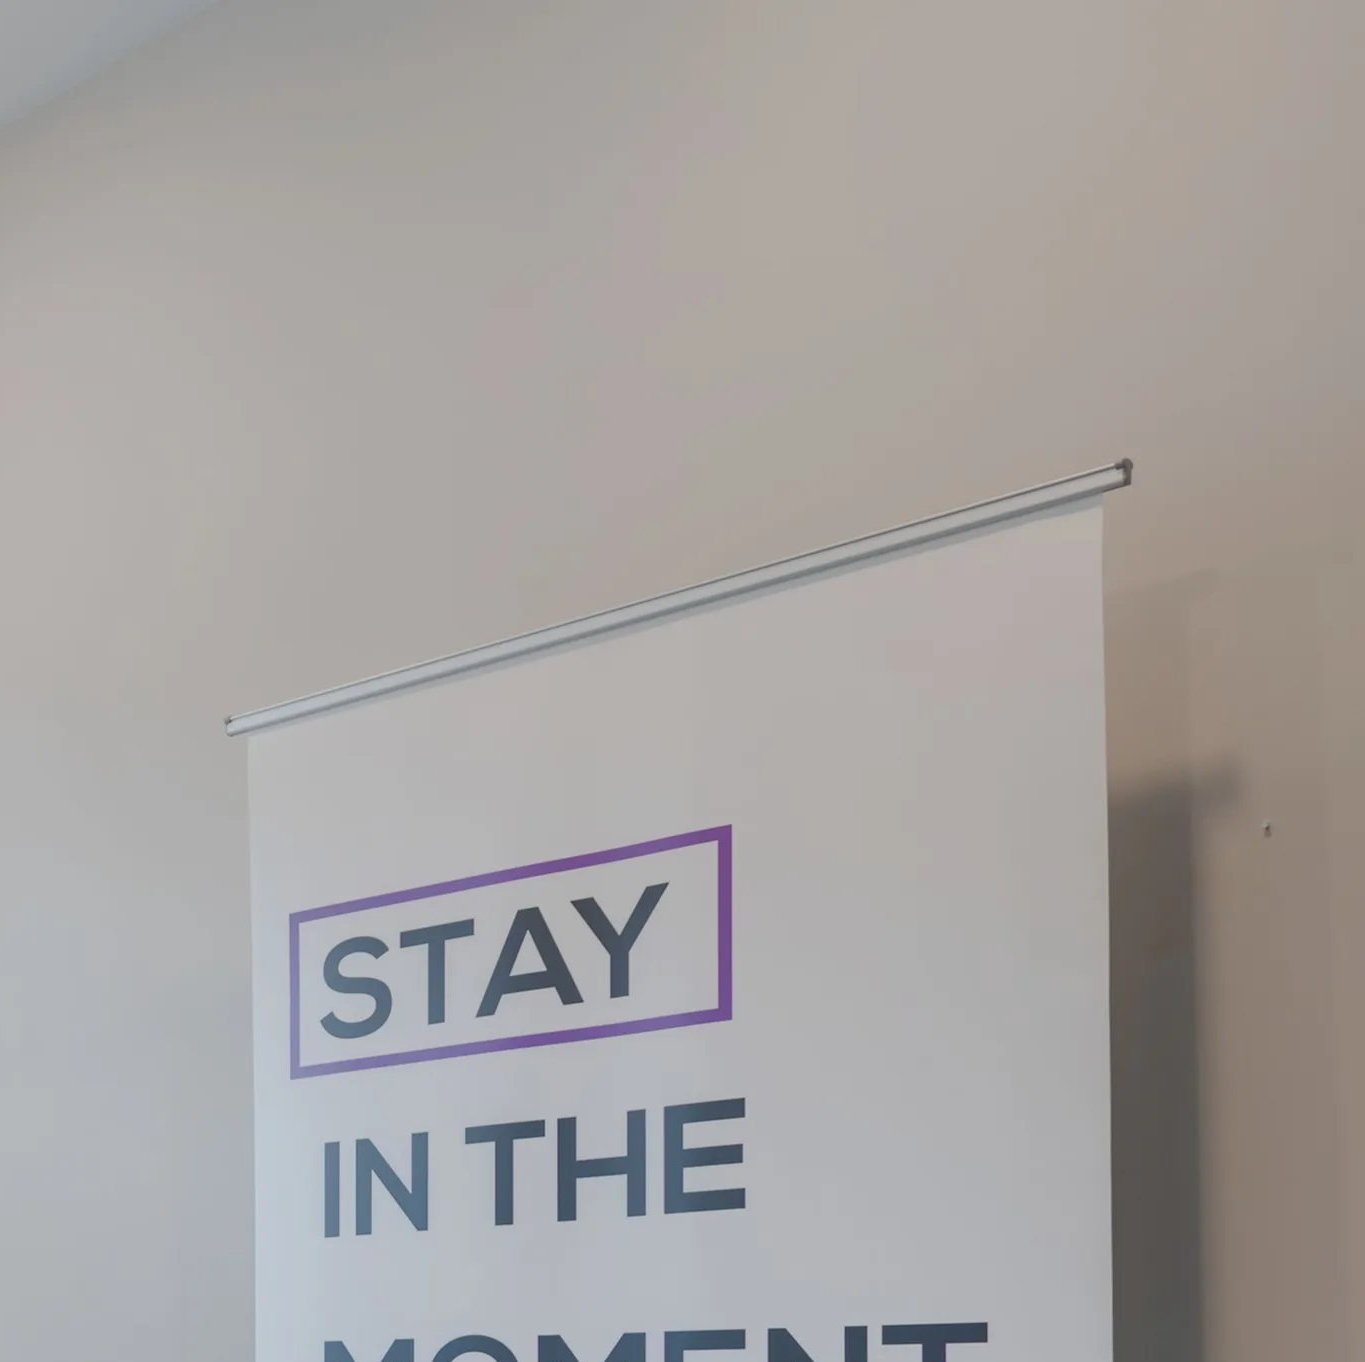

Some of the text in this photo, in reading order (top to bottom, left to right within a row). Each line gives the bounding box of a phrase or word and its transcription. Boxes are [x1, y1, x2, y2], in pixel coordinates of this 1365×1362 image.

[319, 882, 670, 1040] STAY
[324, 1097, 746, 1238] IN THE
